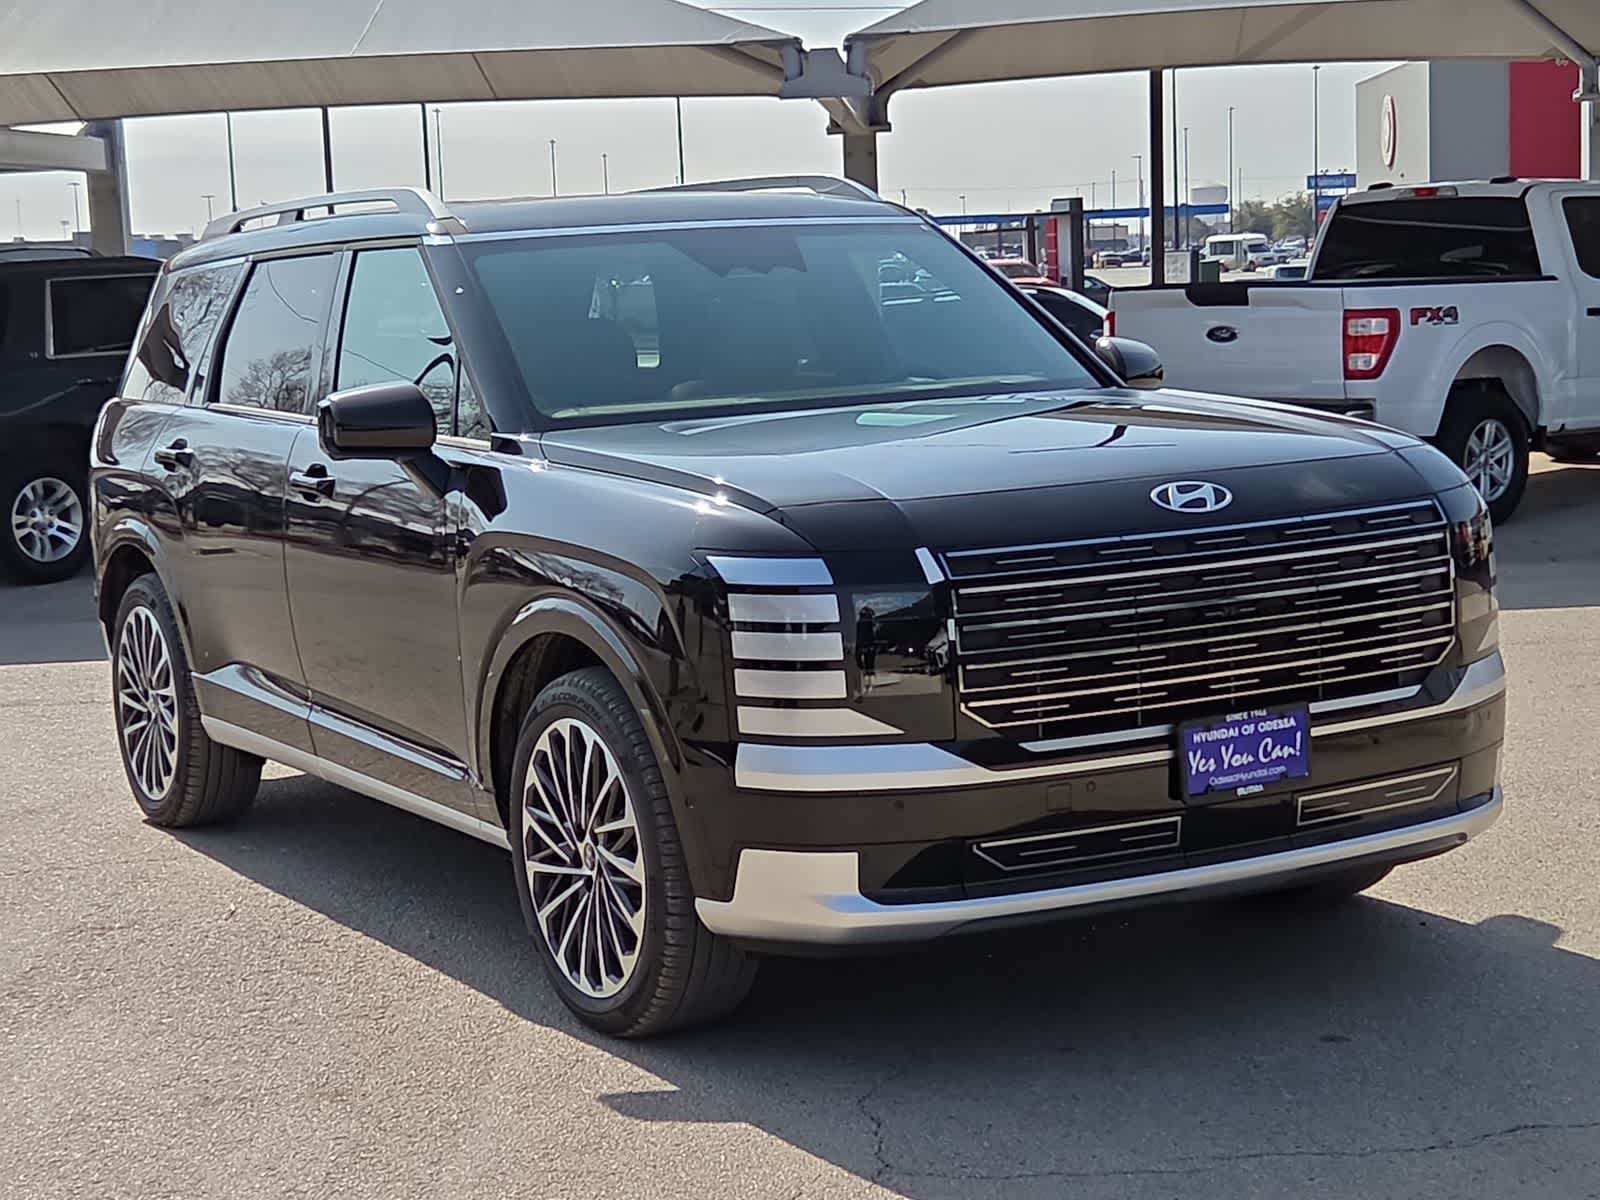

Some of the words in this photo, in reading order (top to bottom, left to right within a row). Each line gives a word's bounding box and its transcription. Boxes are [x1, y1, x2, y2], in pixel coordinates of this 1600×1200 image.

[1409, 305, 1459, 326] FX4
[1192, 727, 1238, 744] HYUNDAI
[1241, 723, 1255, 735] OF
[1258, 716, 1297, 731] ODESSA
[1188, 750, 1216, 775] Yes
[1220, 744, 1254, 769] You
[1258, 731, 1301, 763] Can!
